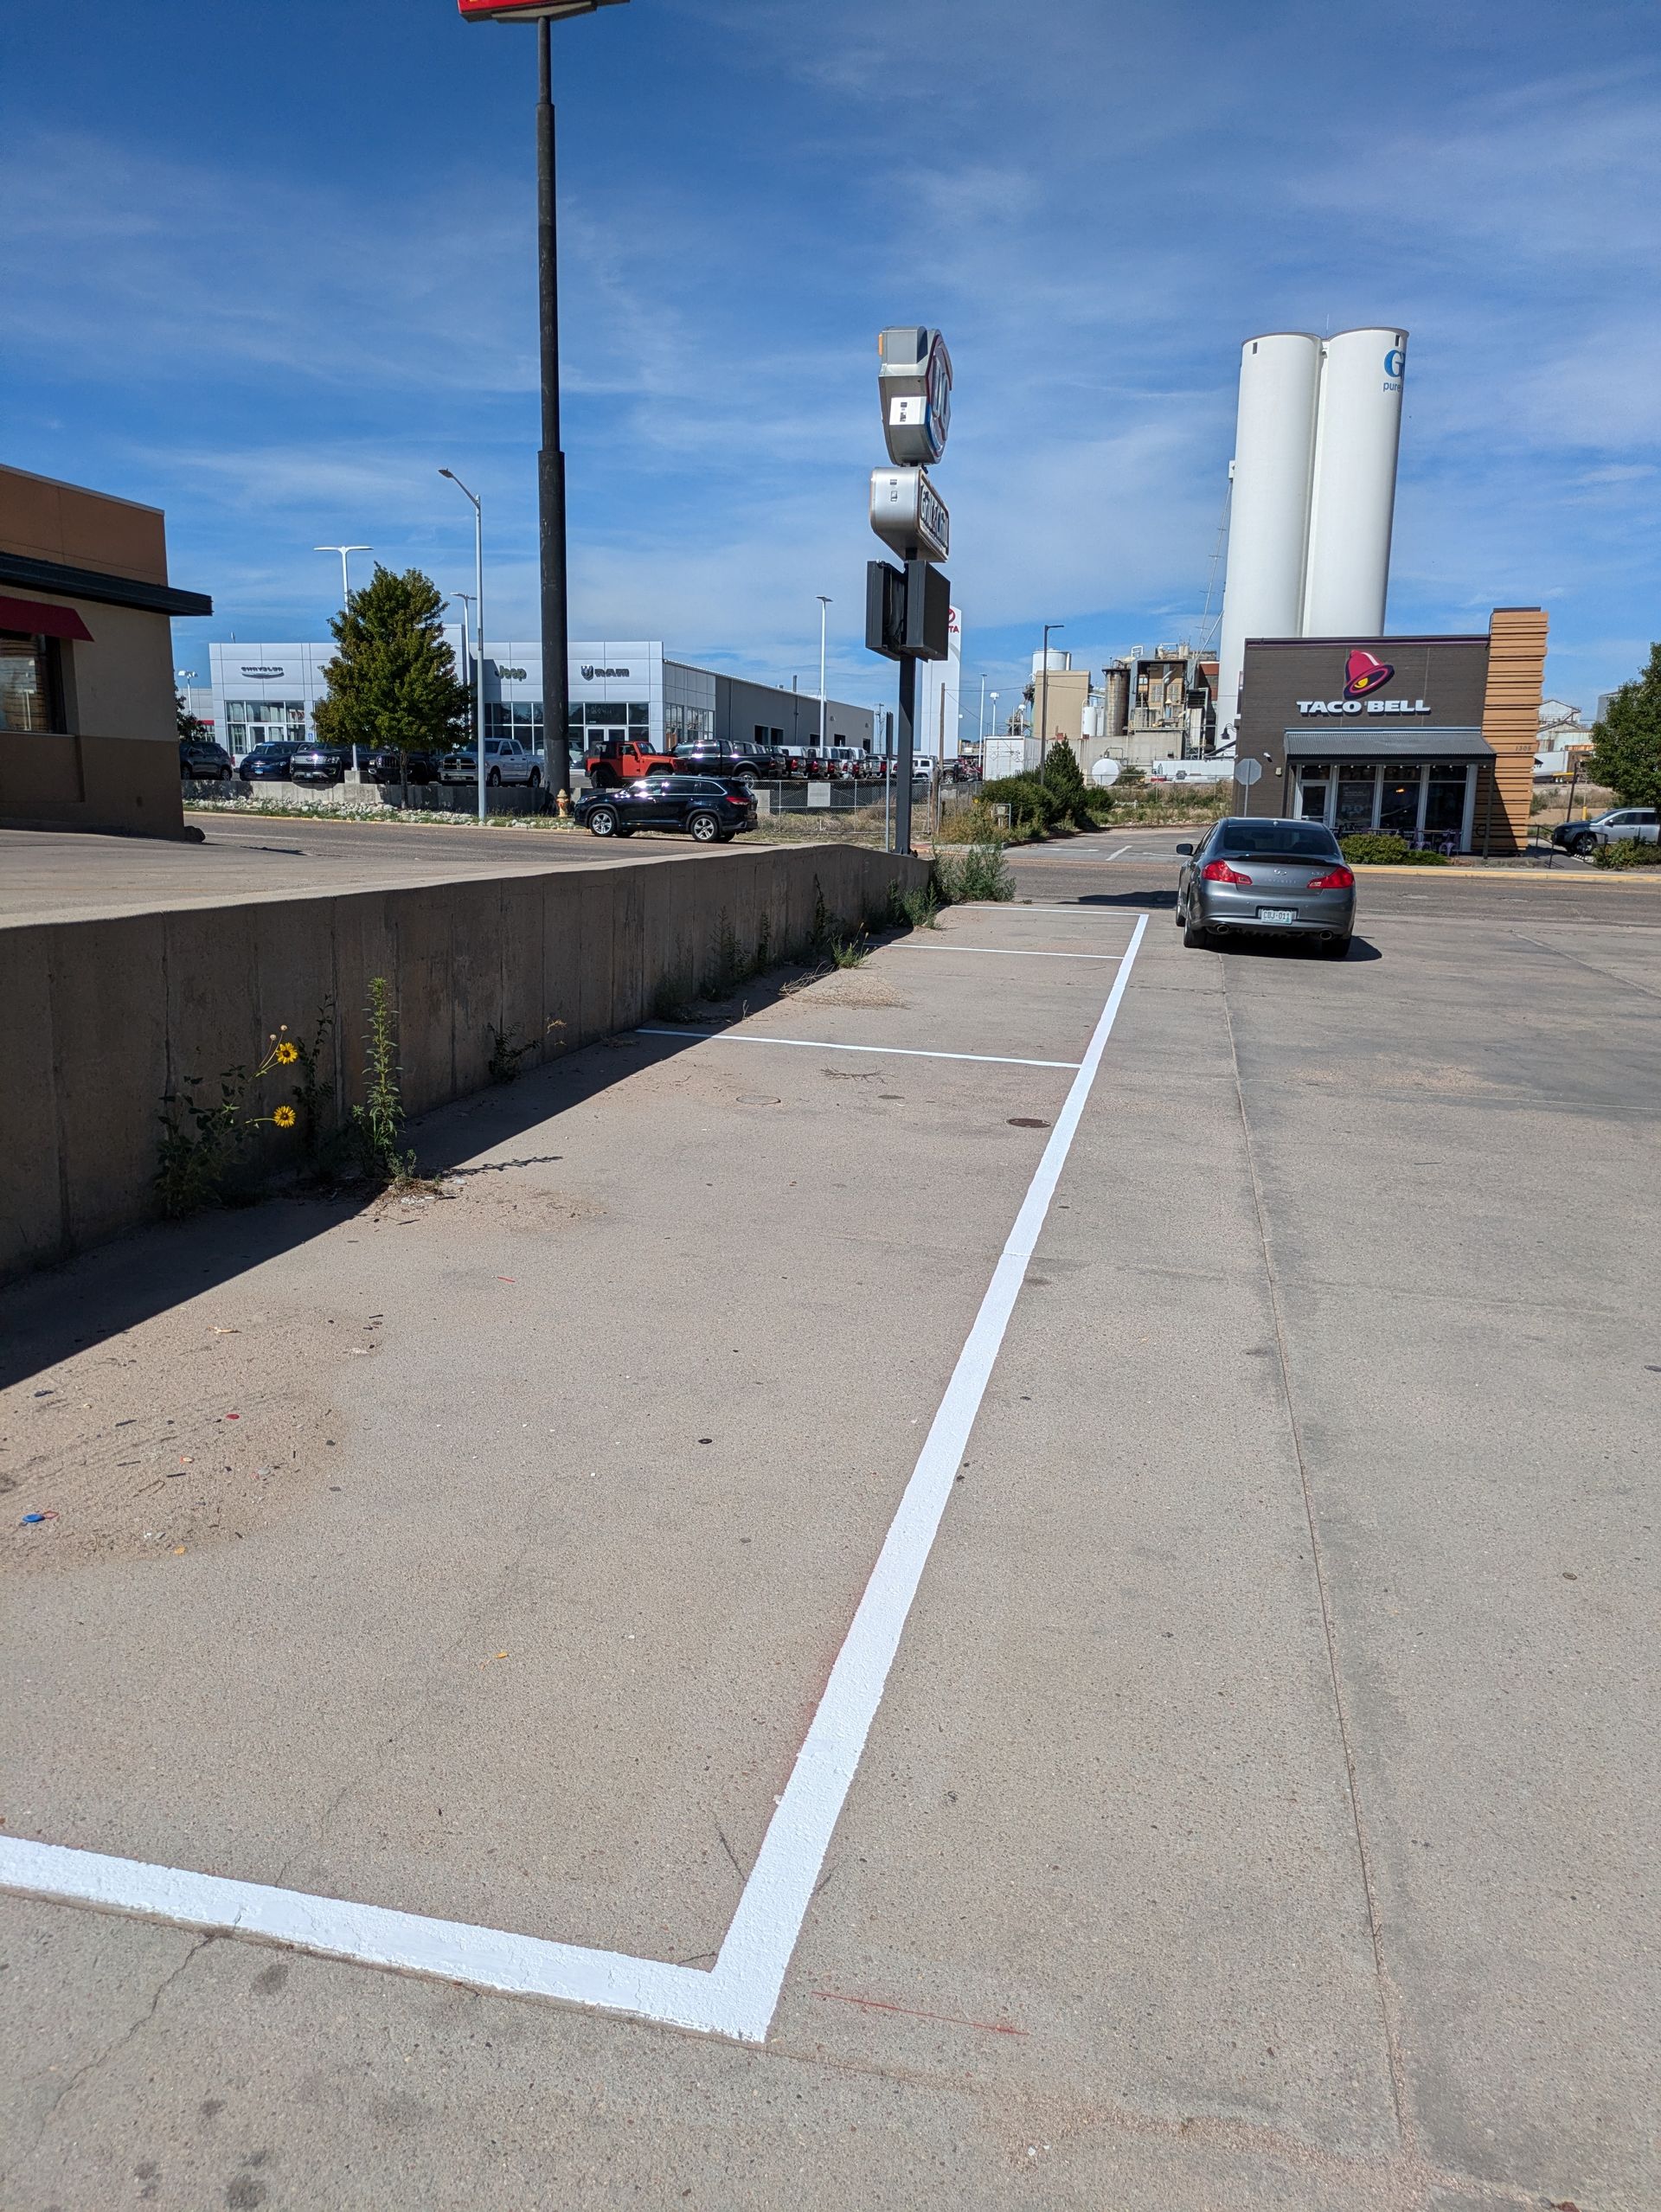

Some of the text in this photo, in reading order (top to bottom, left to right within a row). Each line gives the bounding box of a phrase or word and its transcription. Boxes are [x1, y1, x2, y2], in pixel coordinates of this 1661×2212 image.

[494, 665, 527, 682] Jeep
[594, 669, 630, 677] RAM
[1296, 699, 1431, 714] TACO BELL
